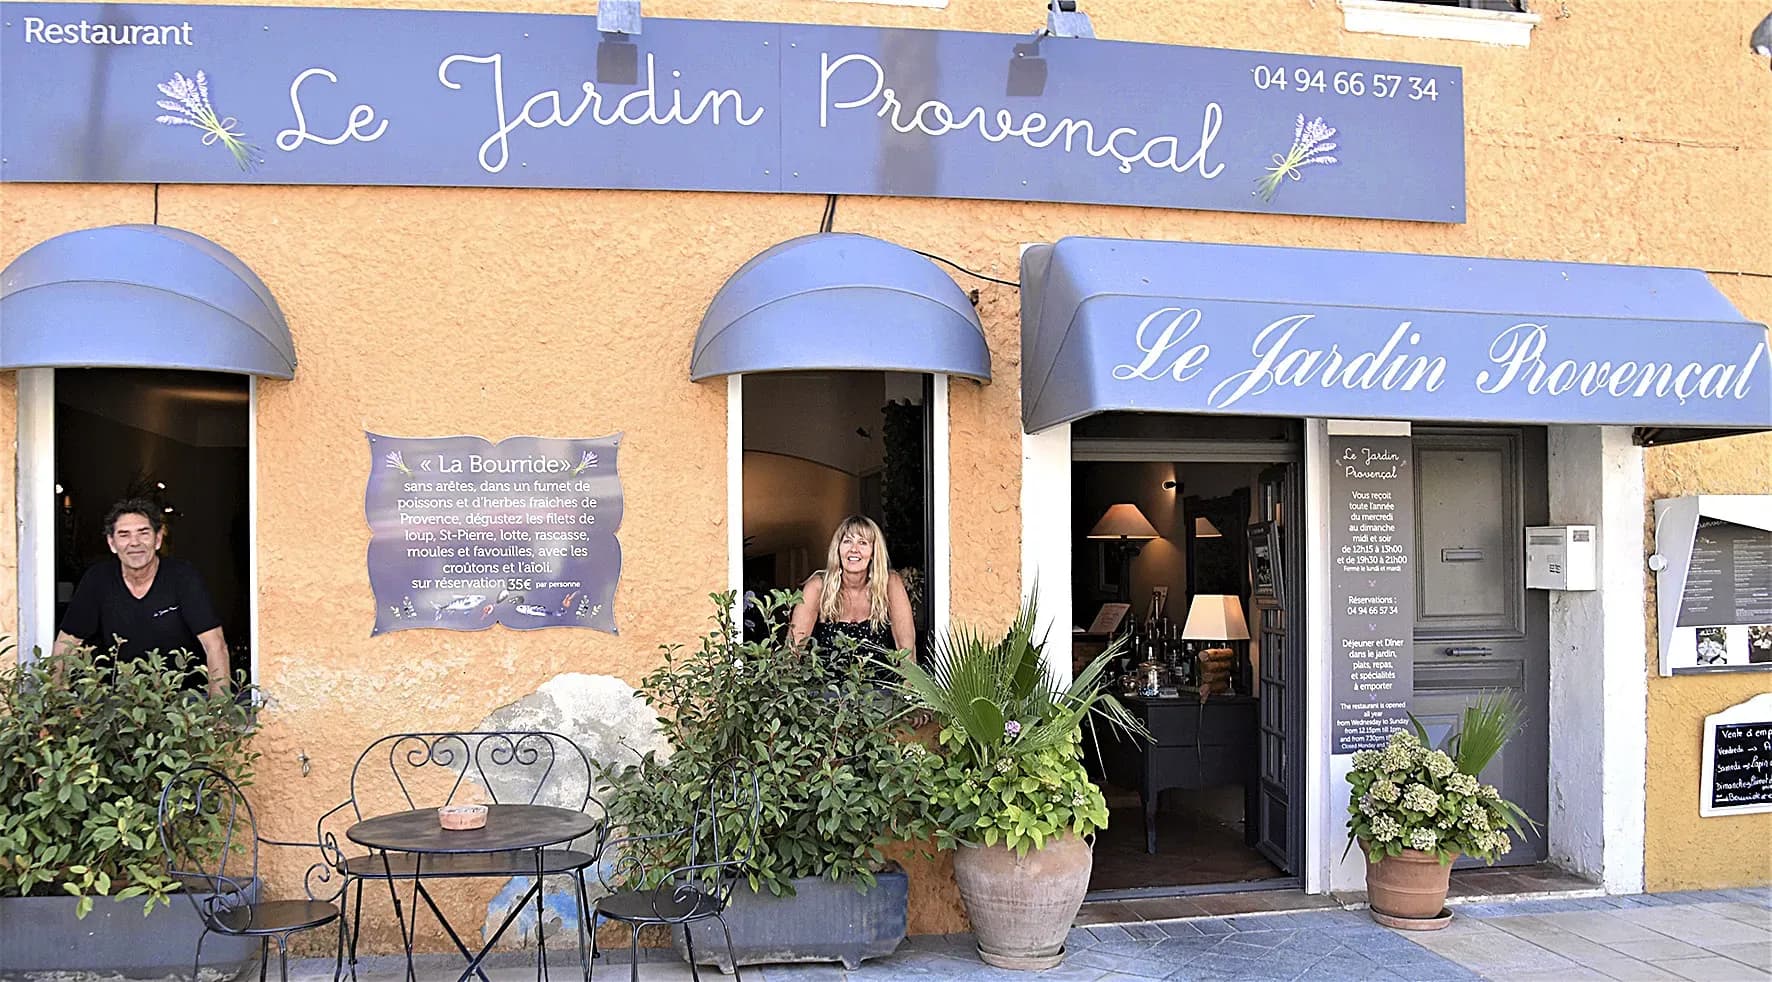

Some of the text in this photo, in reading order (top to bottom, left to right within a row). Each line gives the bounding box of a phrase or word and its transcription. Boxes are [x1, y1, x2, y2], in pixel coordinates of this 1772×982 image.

[24, 18, 192, 47] Restaurant
[1254, 66, 1438, 101] 04 94 66 57 34
[276, 51, 1225, 180] Le Jardin Provençal
[1112, 307, 1764, 409] Le Jardin Provençal
[1344, 448, 1399, 466] Le Jardin
[439, 456, 463, 473] La
[1346, 466, 1397, 479] Provençal
[404, 481, 590, 493] sans arêtes, dans un fumet de
[1352, 491, 1391, 501] Vous reçoit
[398, 498, 453, 511] poissons
[456, 499, 468, 508] et
[472, 498, 525, 508] d'herbes
[581, 498, 596, 508] de
[400, 513, 595, 527] Provence, dégustez les filets de
[1351, 513, 1393, 521] du mercredi
[405, 530, 589, 543] loup, St-Pierre, lotte, rascasse,
[407, 547, 588, 558] moules et favouilles, avec les
[1342, 545, 1351, 553] de
[1353, 545, 1373, 553] 12h15
[1375, 545, 1379, 553] à
[1346, 556, 1355, 564] de
[1380, 556, 1384, 564] à
[443, 563, 499, 573] croûtons
[503, 565, 514, 573] et
[412, 581, 430, 589] sur
[435, 578, 505, 589] réservation
[507, 579, 531, 590] 35€
[1348, 607, 1356, 615] 04
[1343, 640, 1374, 648] Déjeuner
